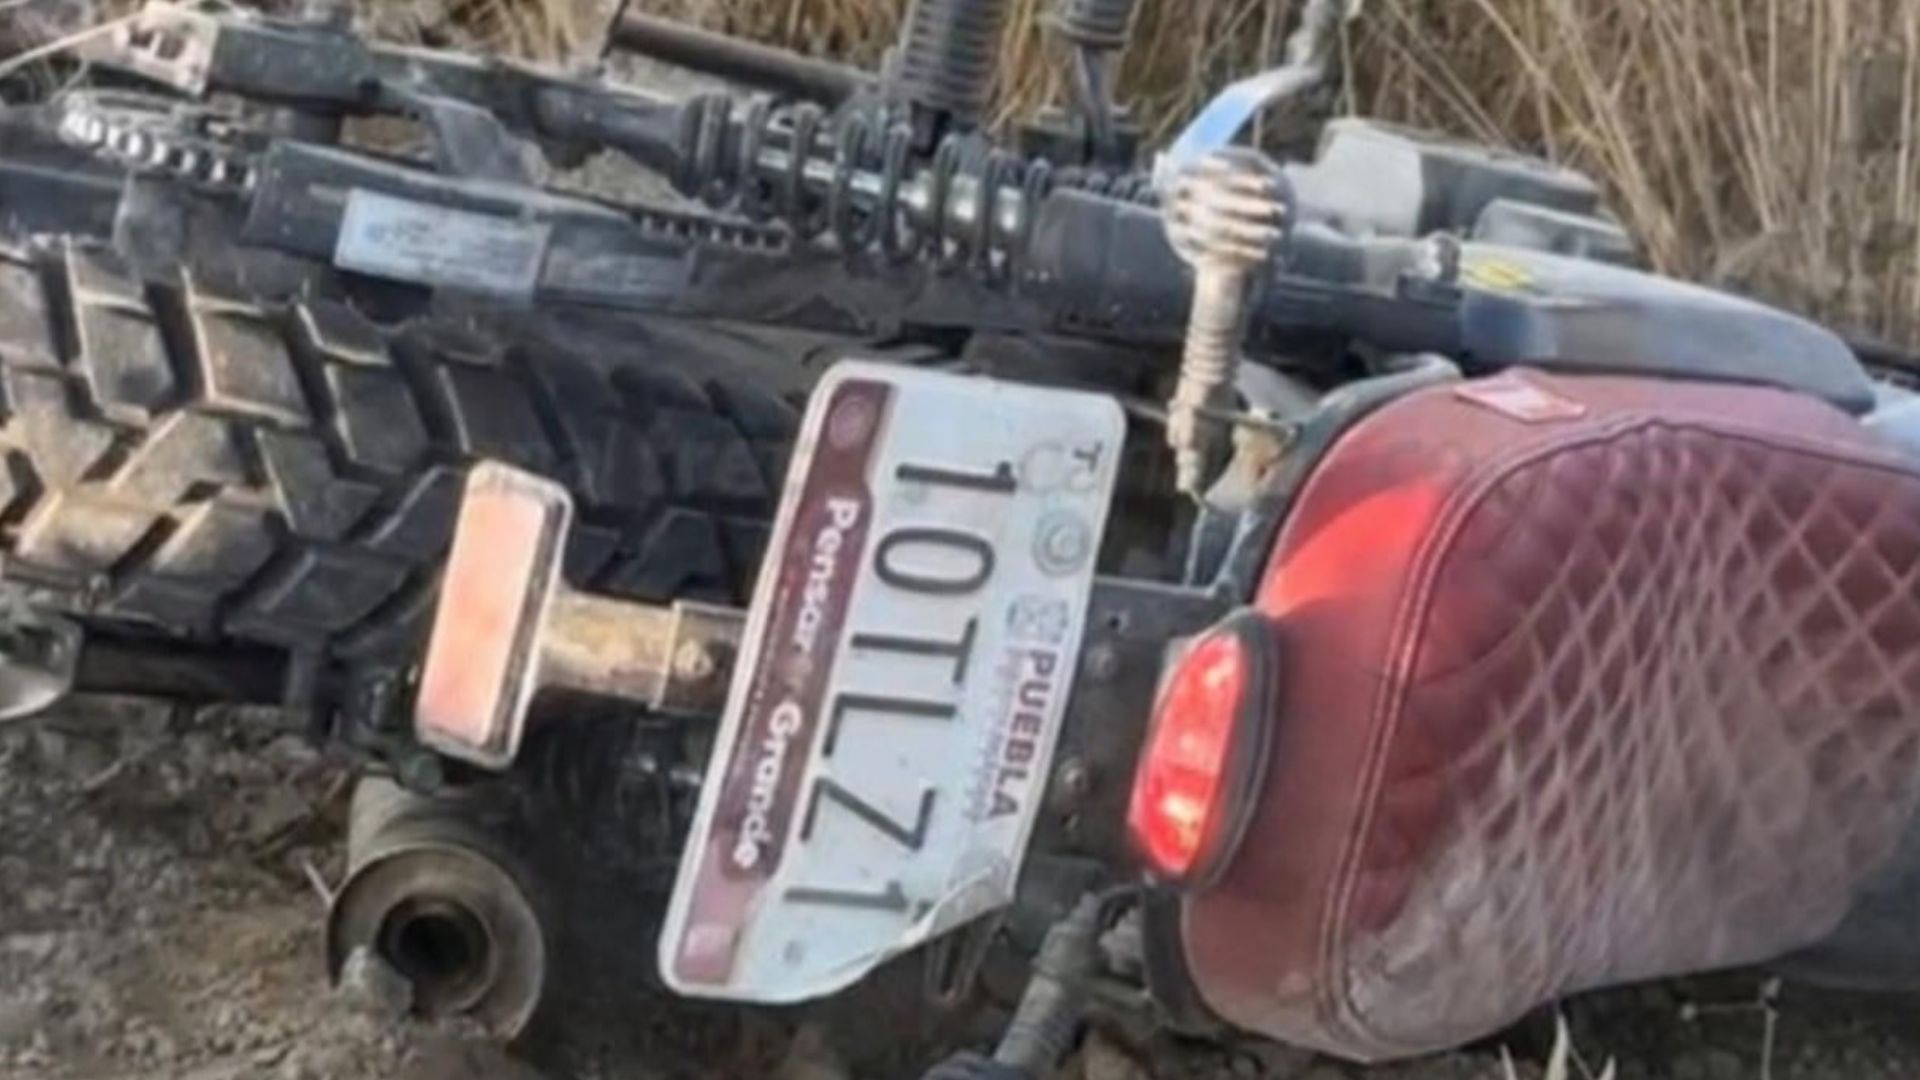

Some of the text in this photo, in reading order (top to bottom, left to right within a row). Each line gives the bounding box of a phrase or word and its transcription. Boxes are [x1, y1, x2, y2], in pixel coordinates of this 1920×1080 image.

[799, 497, 859, 655] Pensar
[784, 461, 1017, 911] 10TLZ1
[988, 652, 1057, 821] PUEBLA
[733, 701, 801, 871] Grande
